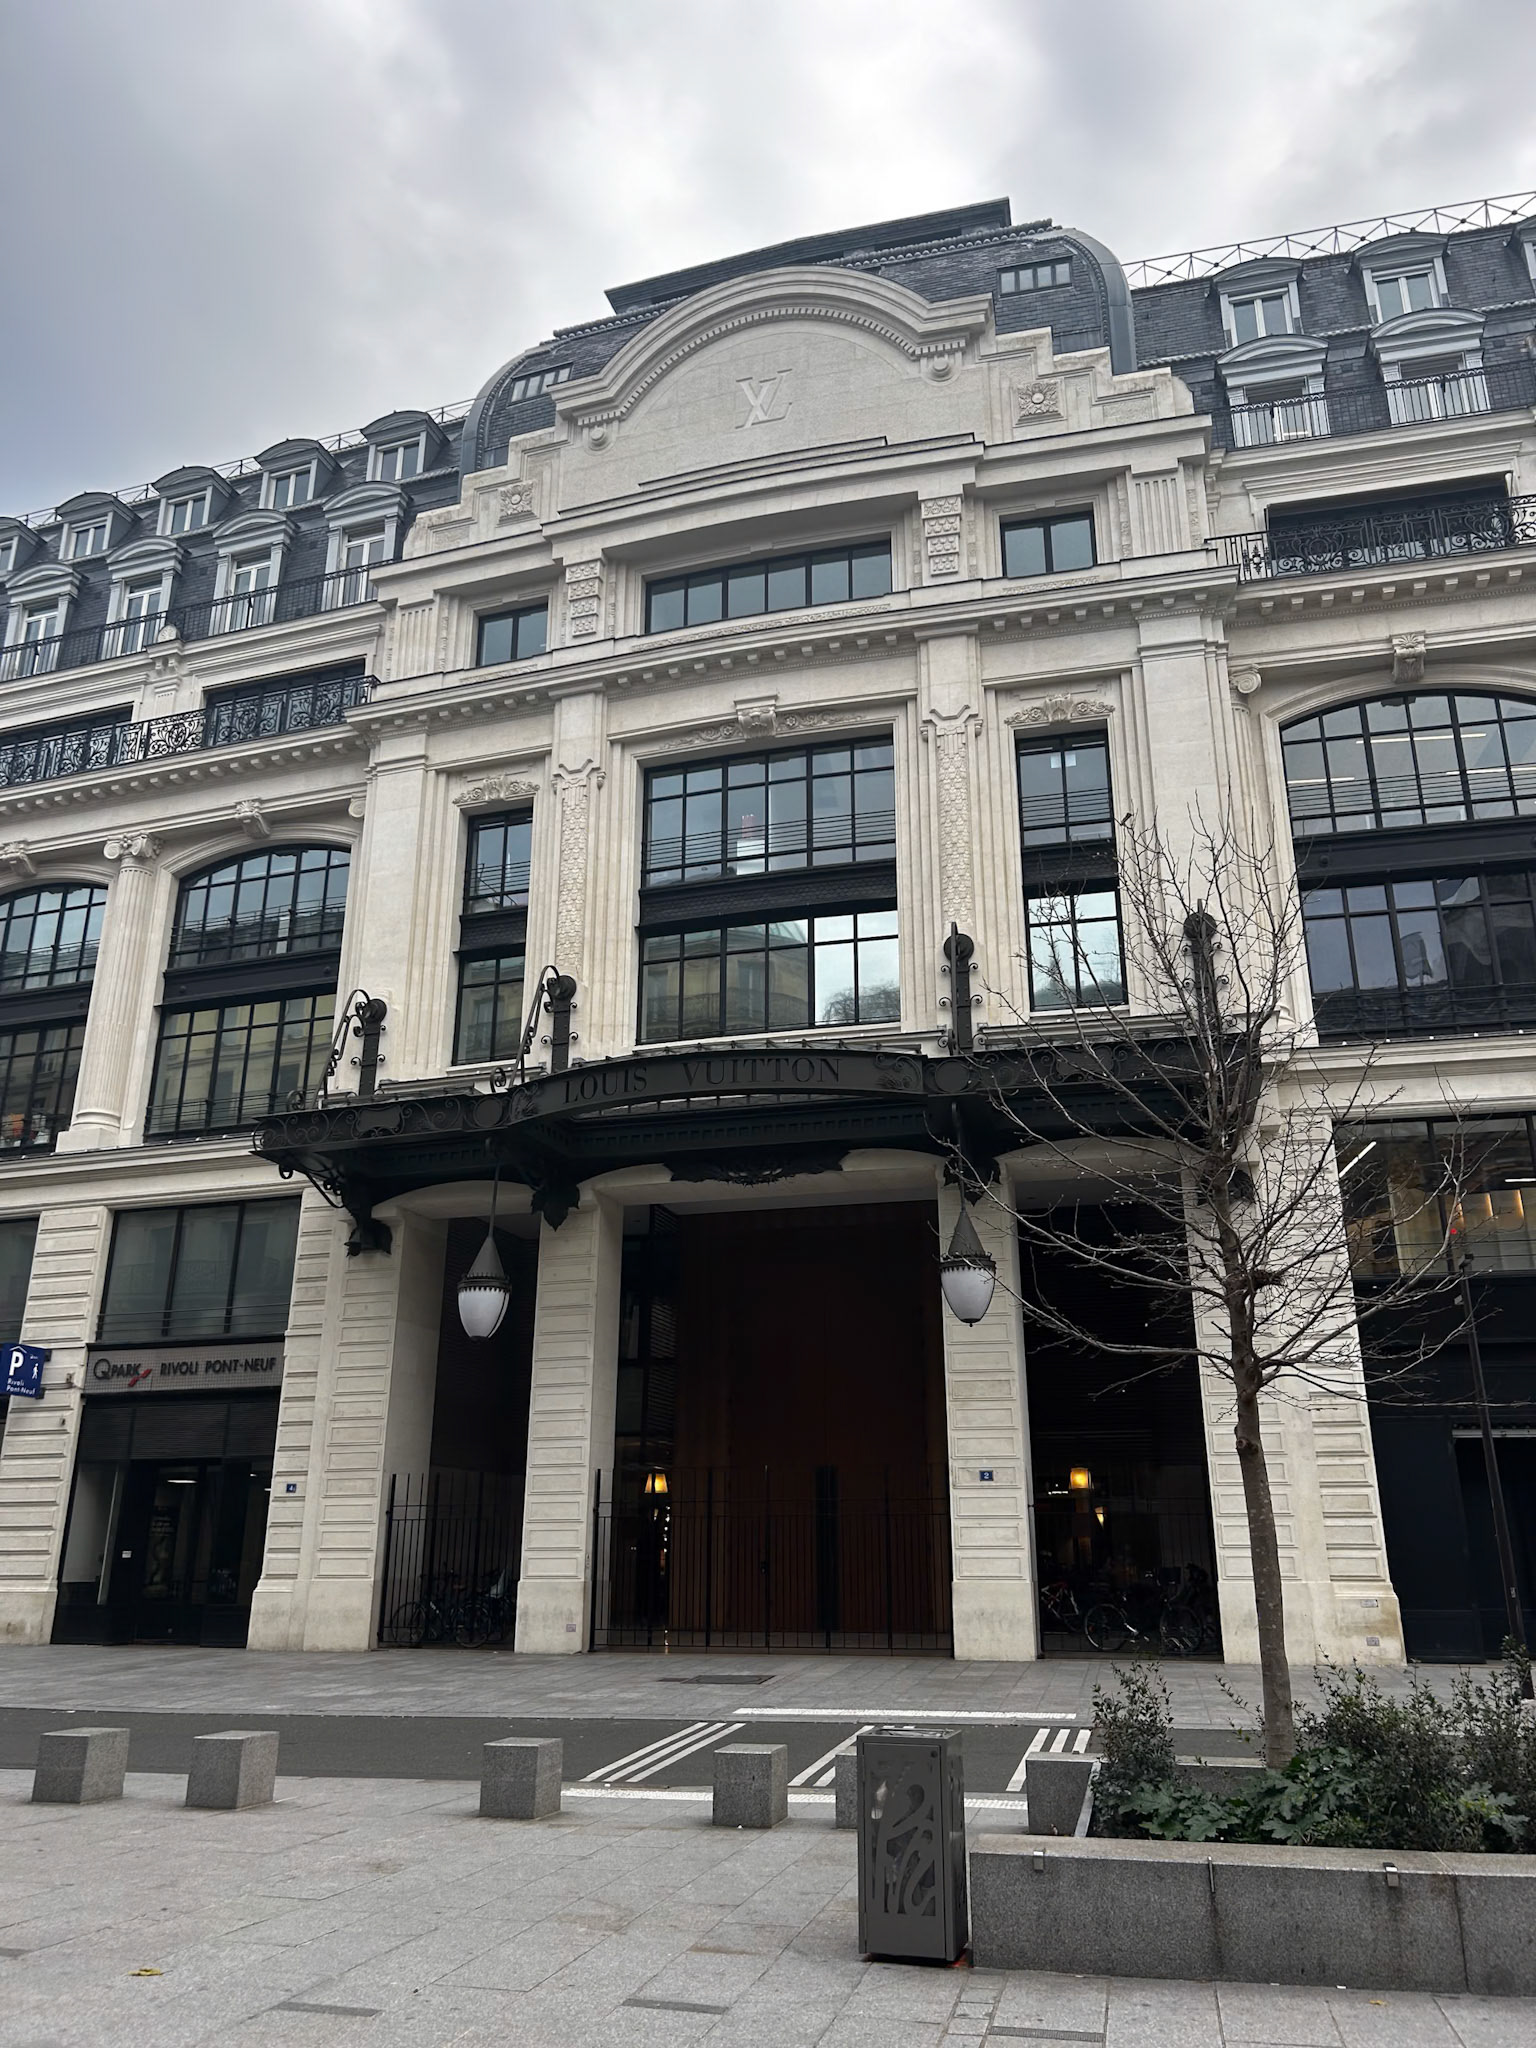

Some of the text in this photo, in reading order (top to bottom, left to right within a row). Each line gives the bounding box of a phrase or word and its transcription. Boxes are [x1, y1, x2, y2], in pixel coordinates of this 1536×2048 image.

[564, 1057, 842, 1104] LOUIS VUITTON
[9, 1351, 24, 1376] P
[159, 1361, 199, 1376] RIVOLI
[204, 1357, 277, 1374] PONT-NEUF
[983, 1471, 990, 1480] 2
